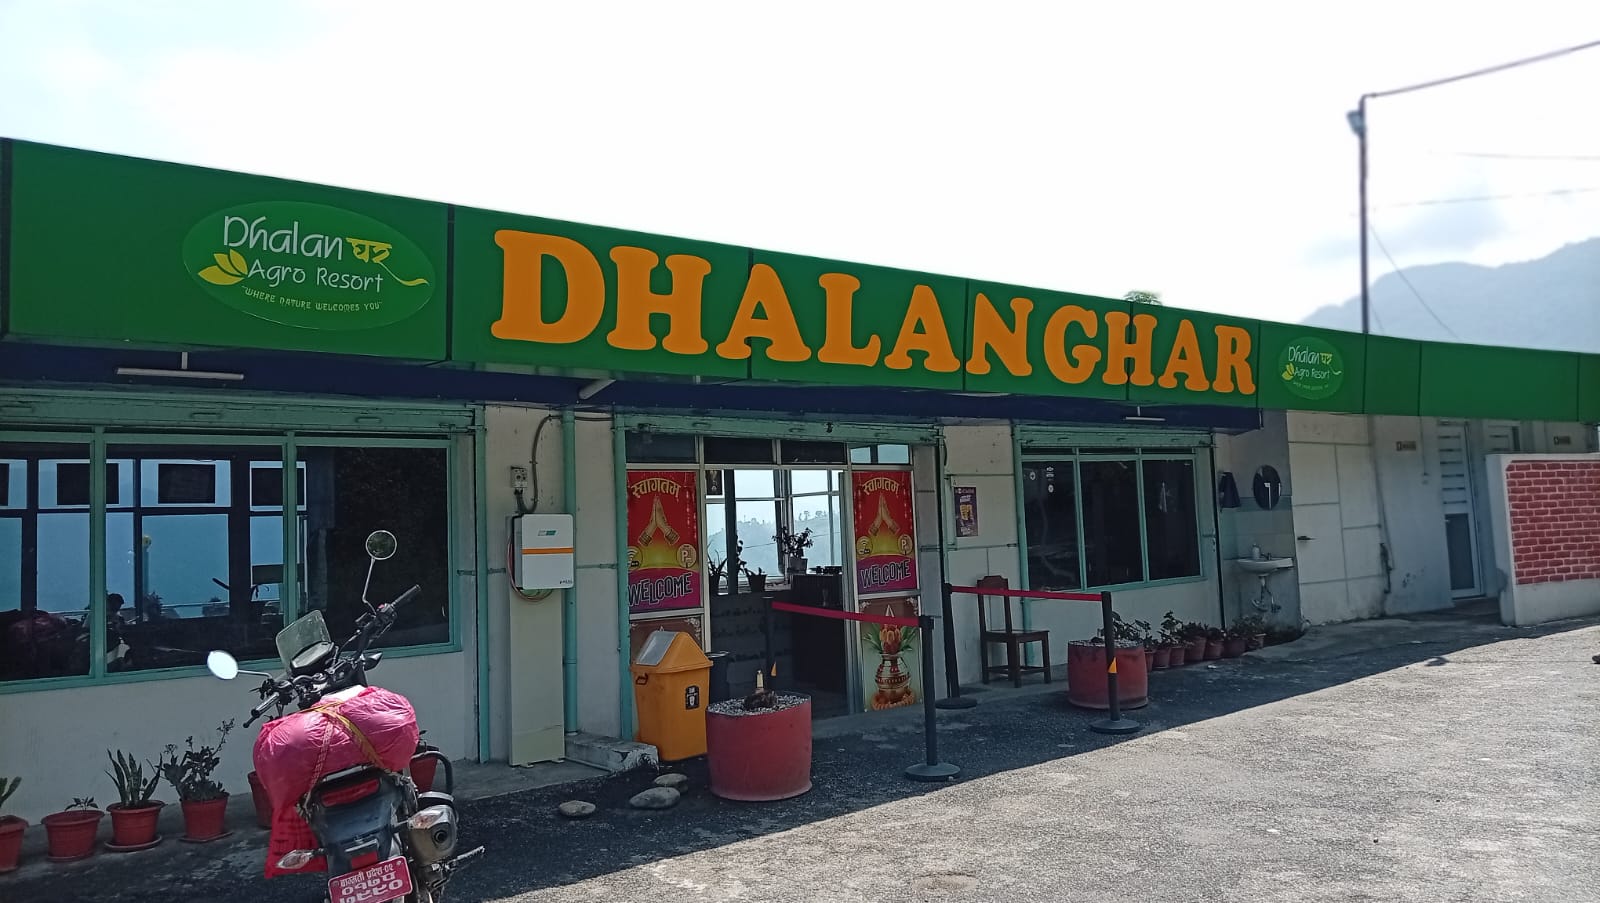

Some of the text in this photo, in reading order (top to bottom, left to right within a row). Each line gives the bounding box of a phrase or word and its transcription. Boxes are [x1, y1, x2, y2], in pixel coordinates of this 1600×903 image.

[223, 215, 393, 263] Dhalan घर
[248, 259, 384, 293] Agro Resort
[315, 302, 360, 312] WELCOMES
[491, 229, 1257, 396] DHALANGHAR
[1288, 345, 1320, 364] Dhalan
[1294, 367, 1330, 380] Agro Resort
[628, 572, 694, 606] WELCOME
[861, 559, 911, 588] WELCOME
